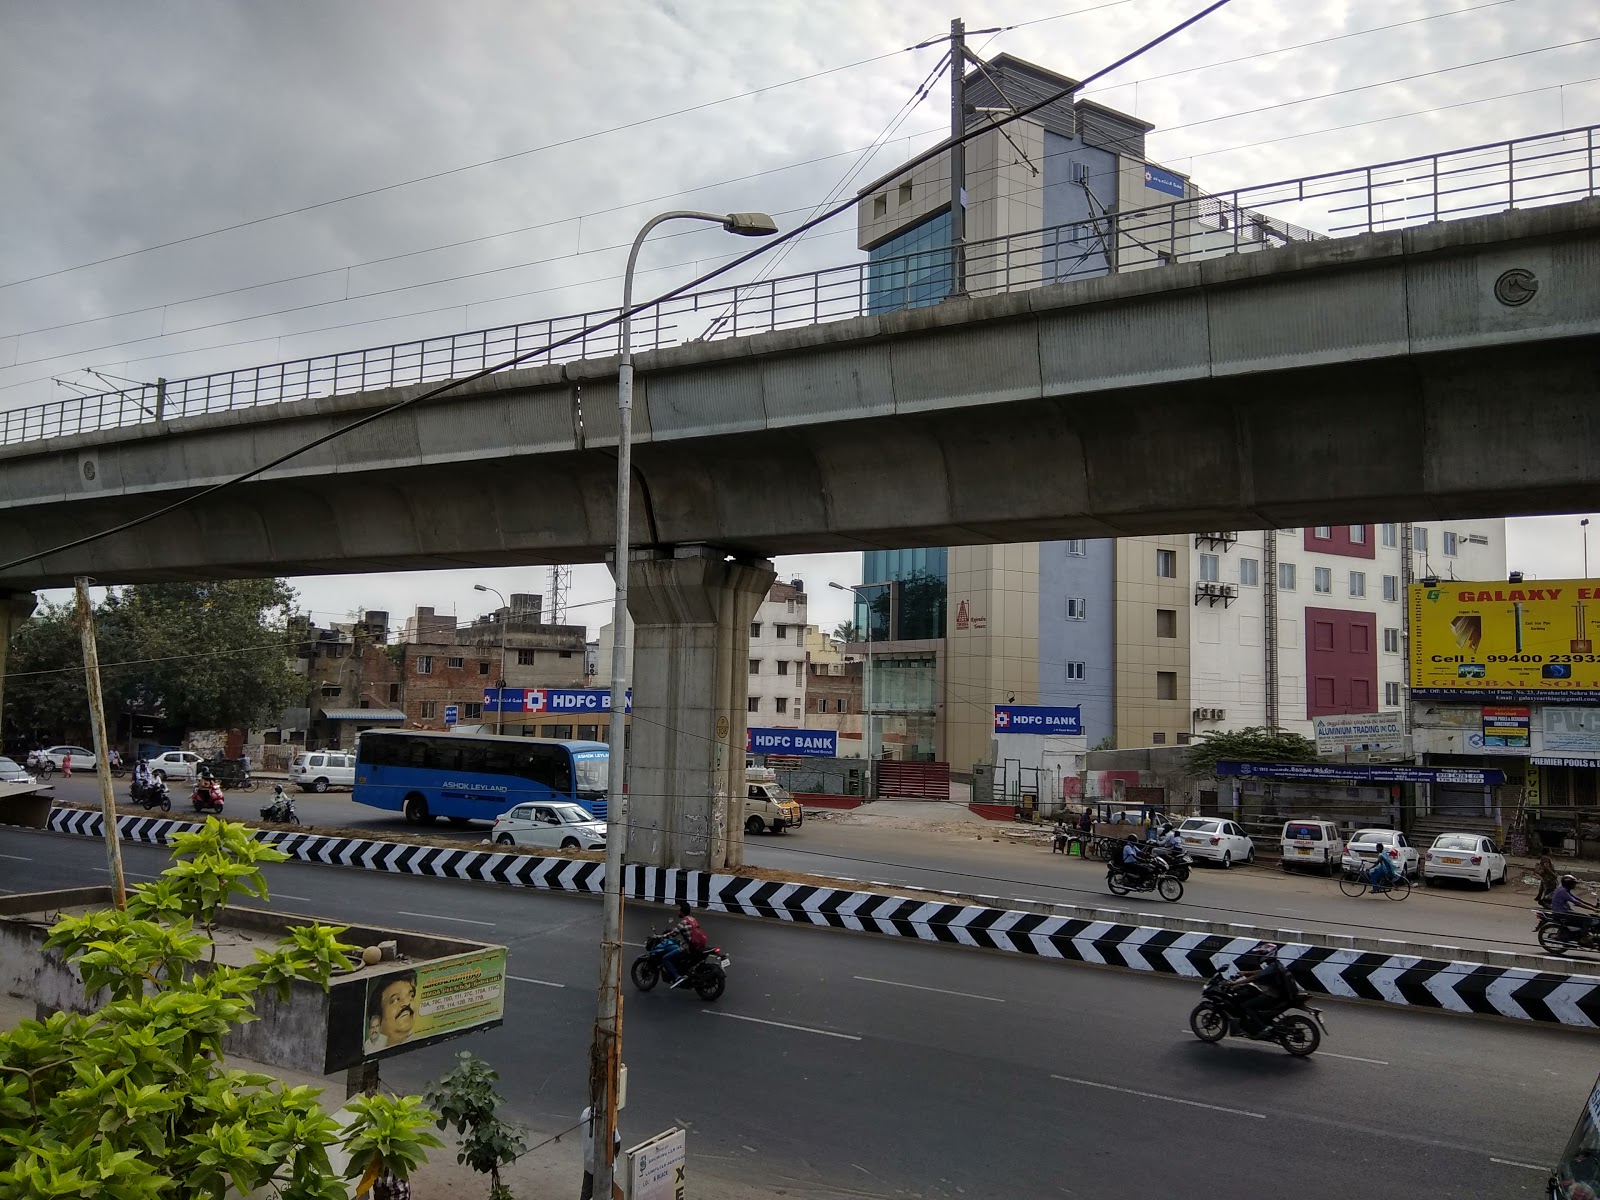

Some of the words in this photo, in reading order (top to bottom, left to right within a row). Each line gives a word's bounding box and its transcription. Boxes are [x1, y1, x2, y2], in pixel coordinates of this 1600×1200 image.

[1458, 588, 1562, 603] GALAXY
[1431, 654, 1464, 663] Cell
[1486, 654, 1542, 663] 99400
[552, 695, 596, 708] HDFC
[1013, 716, 1042, 724] HDFC
[1046, 717, 1076, 725] BANK
[1546, 712, 1600, 733] PVC
[1318, 726, 1352, 736] ALUMINIUM
[1354, 725, 1380, 734] TRADING
[756, 735, 790, 747] HDFC
[795, 737, 833, 749] BANK
[1530, 758, 1562, 766] PREMIER
[1564, 759, 1588, 767] POOLS
[442, 782, 470, 790] ASHOK
[471, 784, 507, 793] LEYLAND
[1527, 769, 1537, 798] PVC
